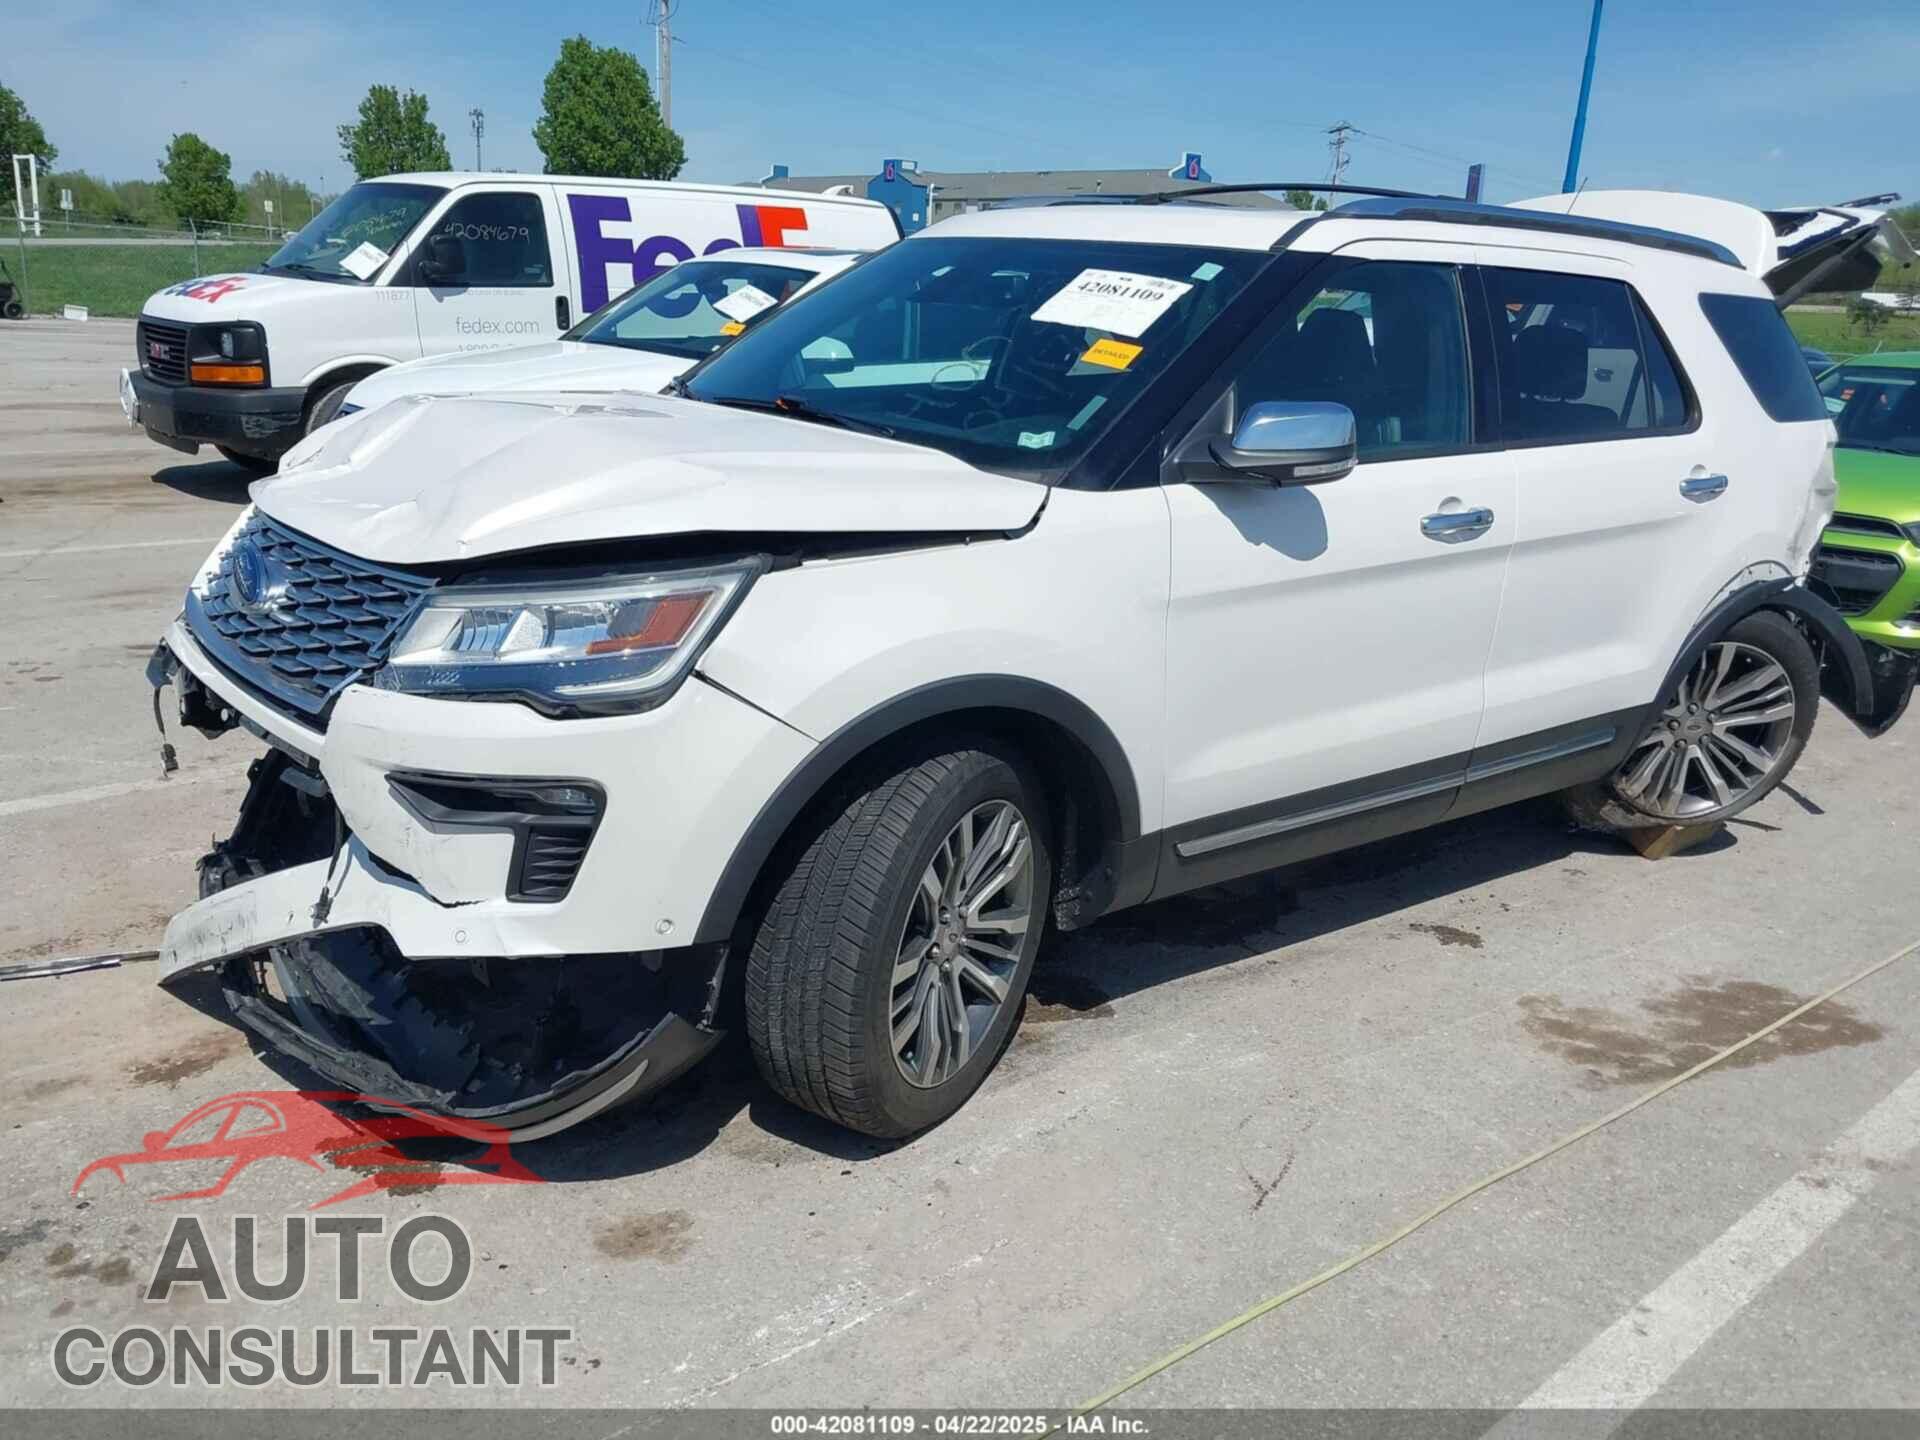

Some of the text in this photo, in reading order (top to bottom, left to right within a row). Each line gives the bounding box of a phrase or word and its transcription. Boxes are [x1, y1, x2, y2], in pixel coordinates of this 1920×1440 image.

[886, 161, 894, 180] 6
[444, 222, 530, 246] 42084679
[1078, 281, 1164, 301] 42081109
[456, 315, 540, 334] fedex.com
